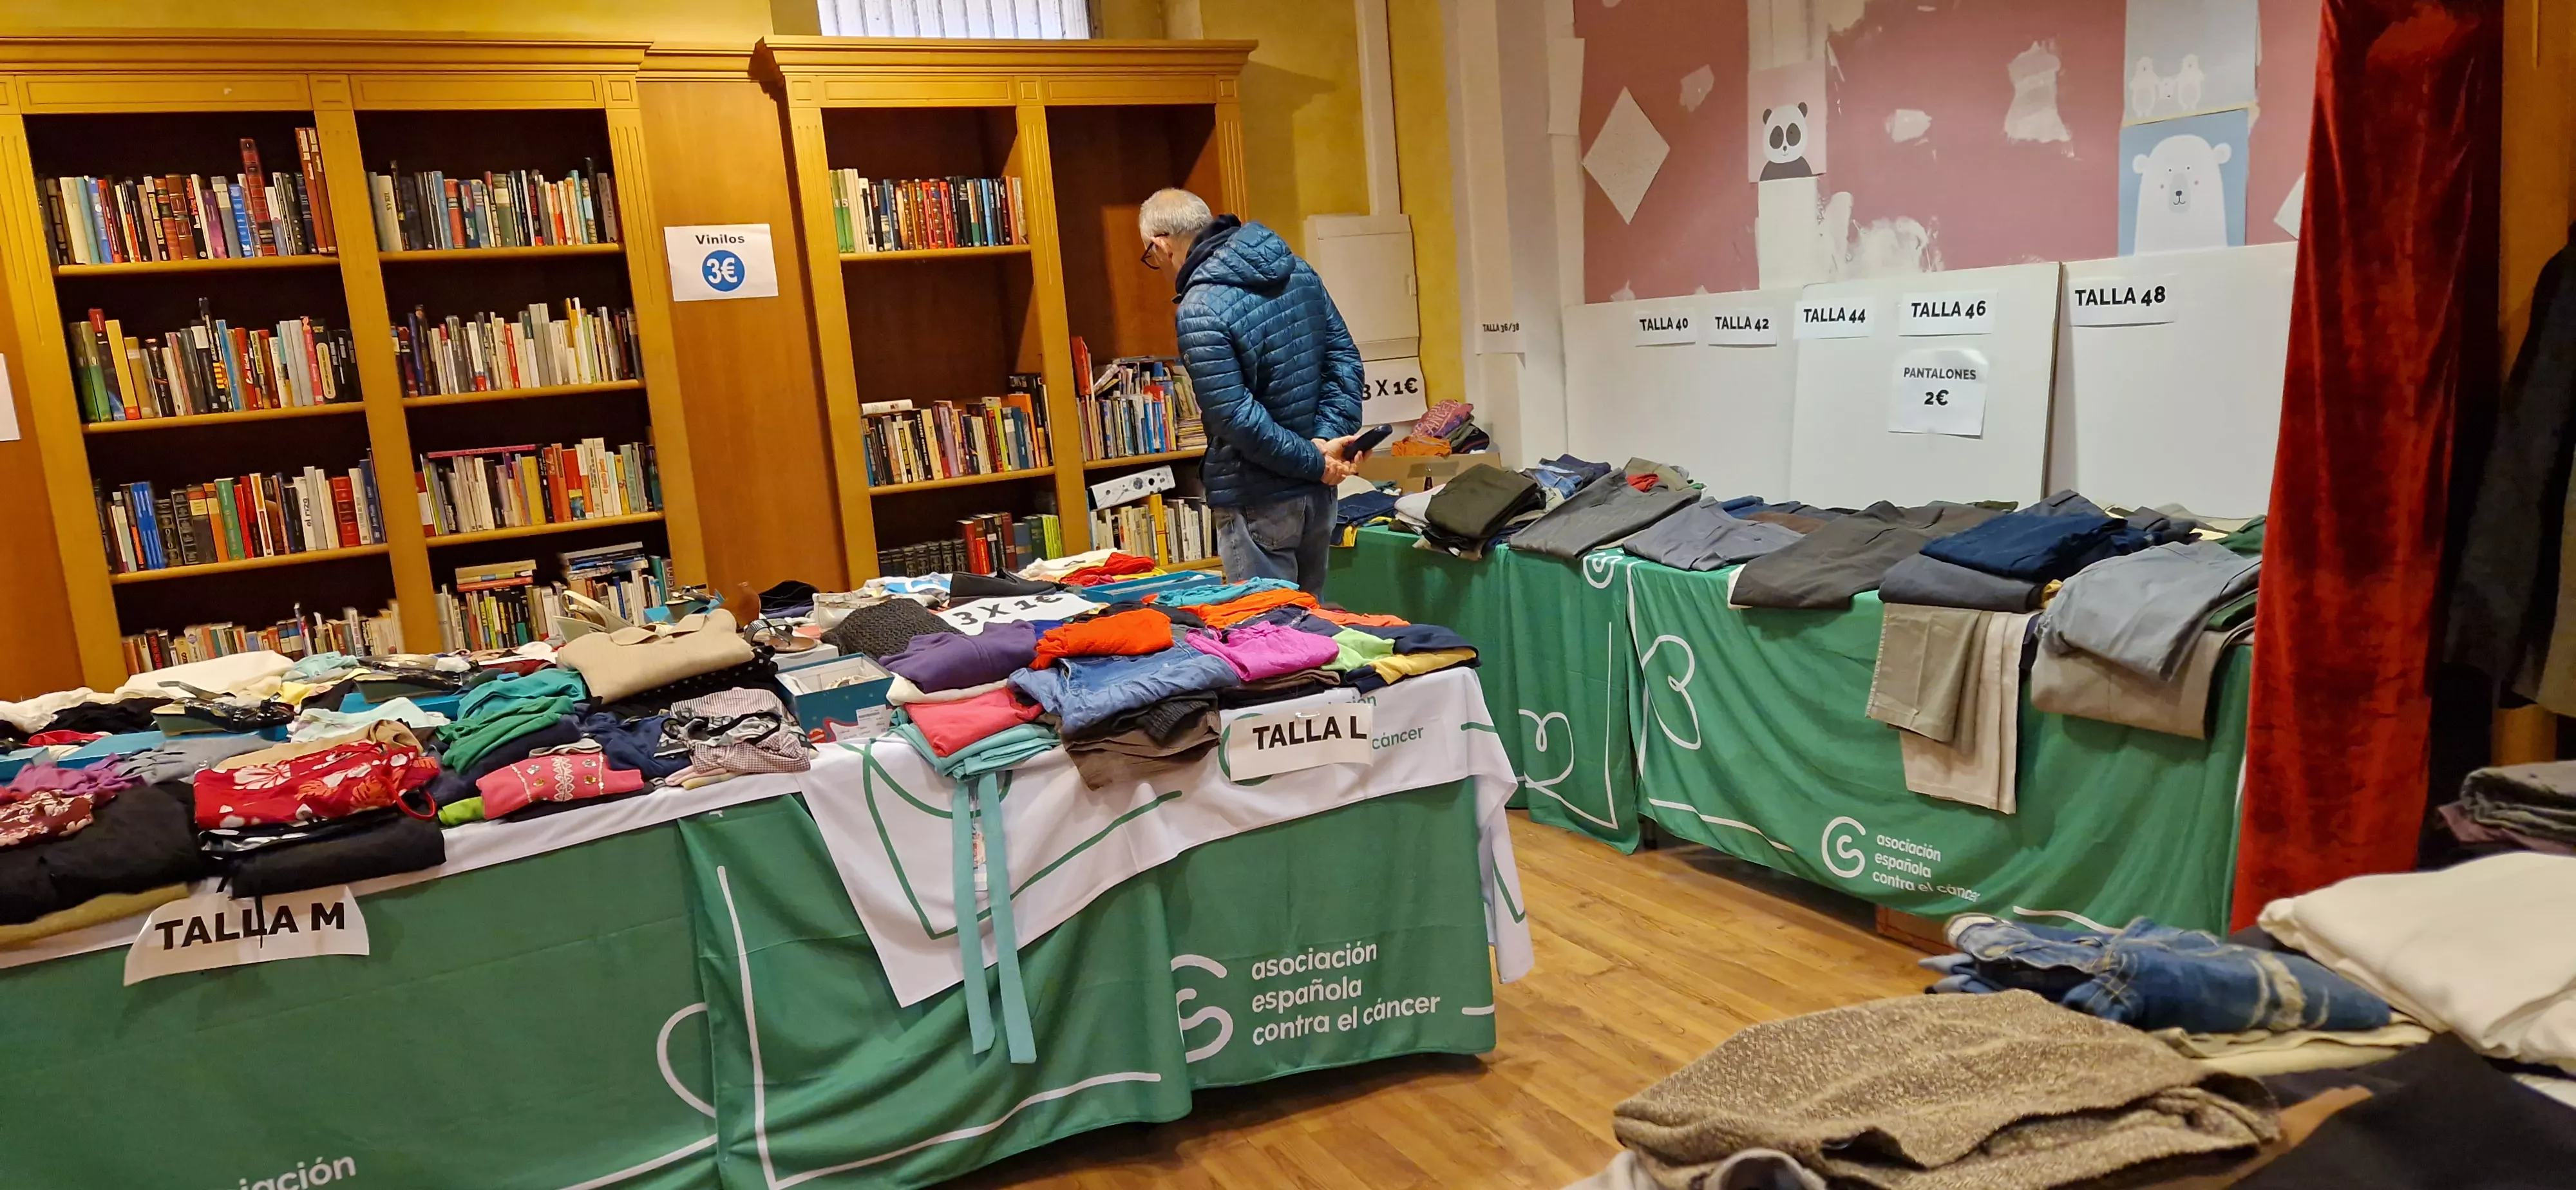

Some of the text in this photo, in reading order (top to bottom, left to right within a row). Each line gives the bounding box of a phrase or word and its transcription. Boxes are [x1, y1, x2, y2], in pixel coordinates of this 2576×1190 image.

[695, 234, 745, 245] Vinilos
[706, 257, 738, 284] 3€
[2074, 285, 2166, 307] TALLA 48
[1803, 307, 1866, 324] TALLA 44
[1911, 300, 1987, 319] TALLA 46
[1482, 323, 1520, 333] TALLA 36/38
[1639, 317, 1689, 331] TALLA 40
[1714, 316, 1770, 332] TALLA 42
[1904, 367, 1977, 380] PANTALONES
[1362, 377, 1419, 401] 3 X 1€
[1924, 390, 1949, 406] 2€
[953, 611, 979, 625] 3
[977, 603, 1011, 618] X
[1253, 715, 1367, 750] TALLA L
[1372, 727, 1424, 750] cáncer
[1877, 834, 1942, 862] asociación
[1875, 853, 1932, 878] española
[1872, 871, 1981, 902] contra el cáncer
[155, 902, 345, 950] TALLA M
[1251, 940, 1378, 981] asociación
[1251, 976, 1363, 1014] española
[1253, 996, 1441, 1046] contra el cáncer
